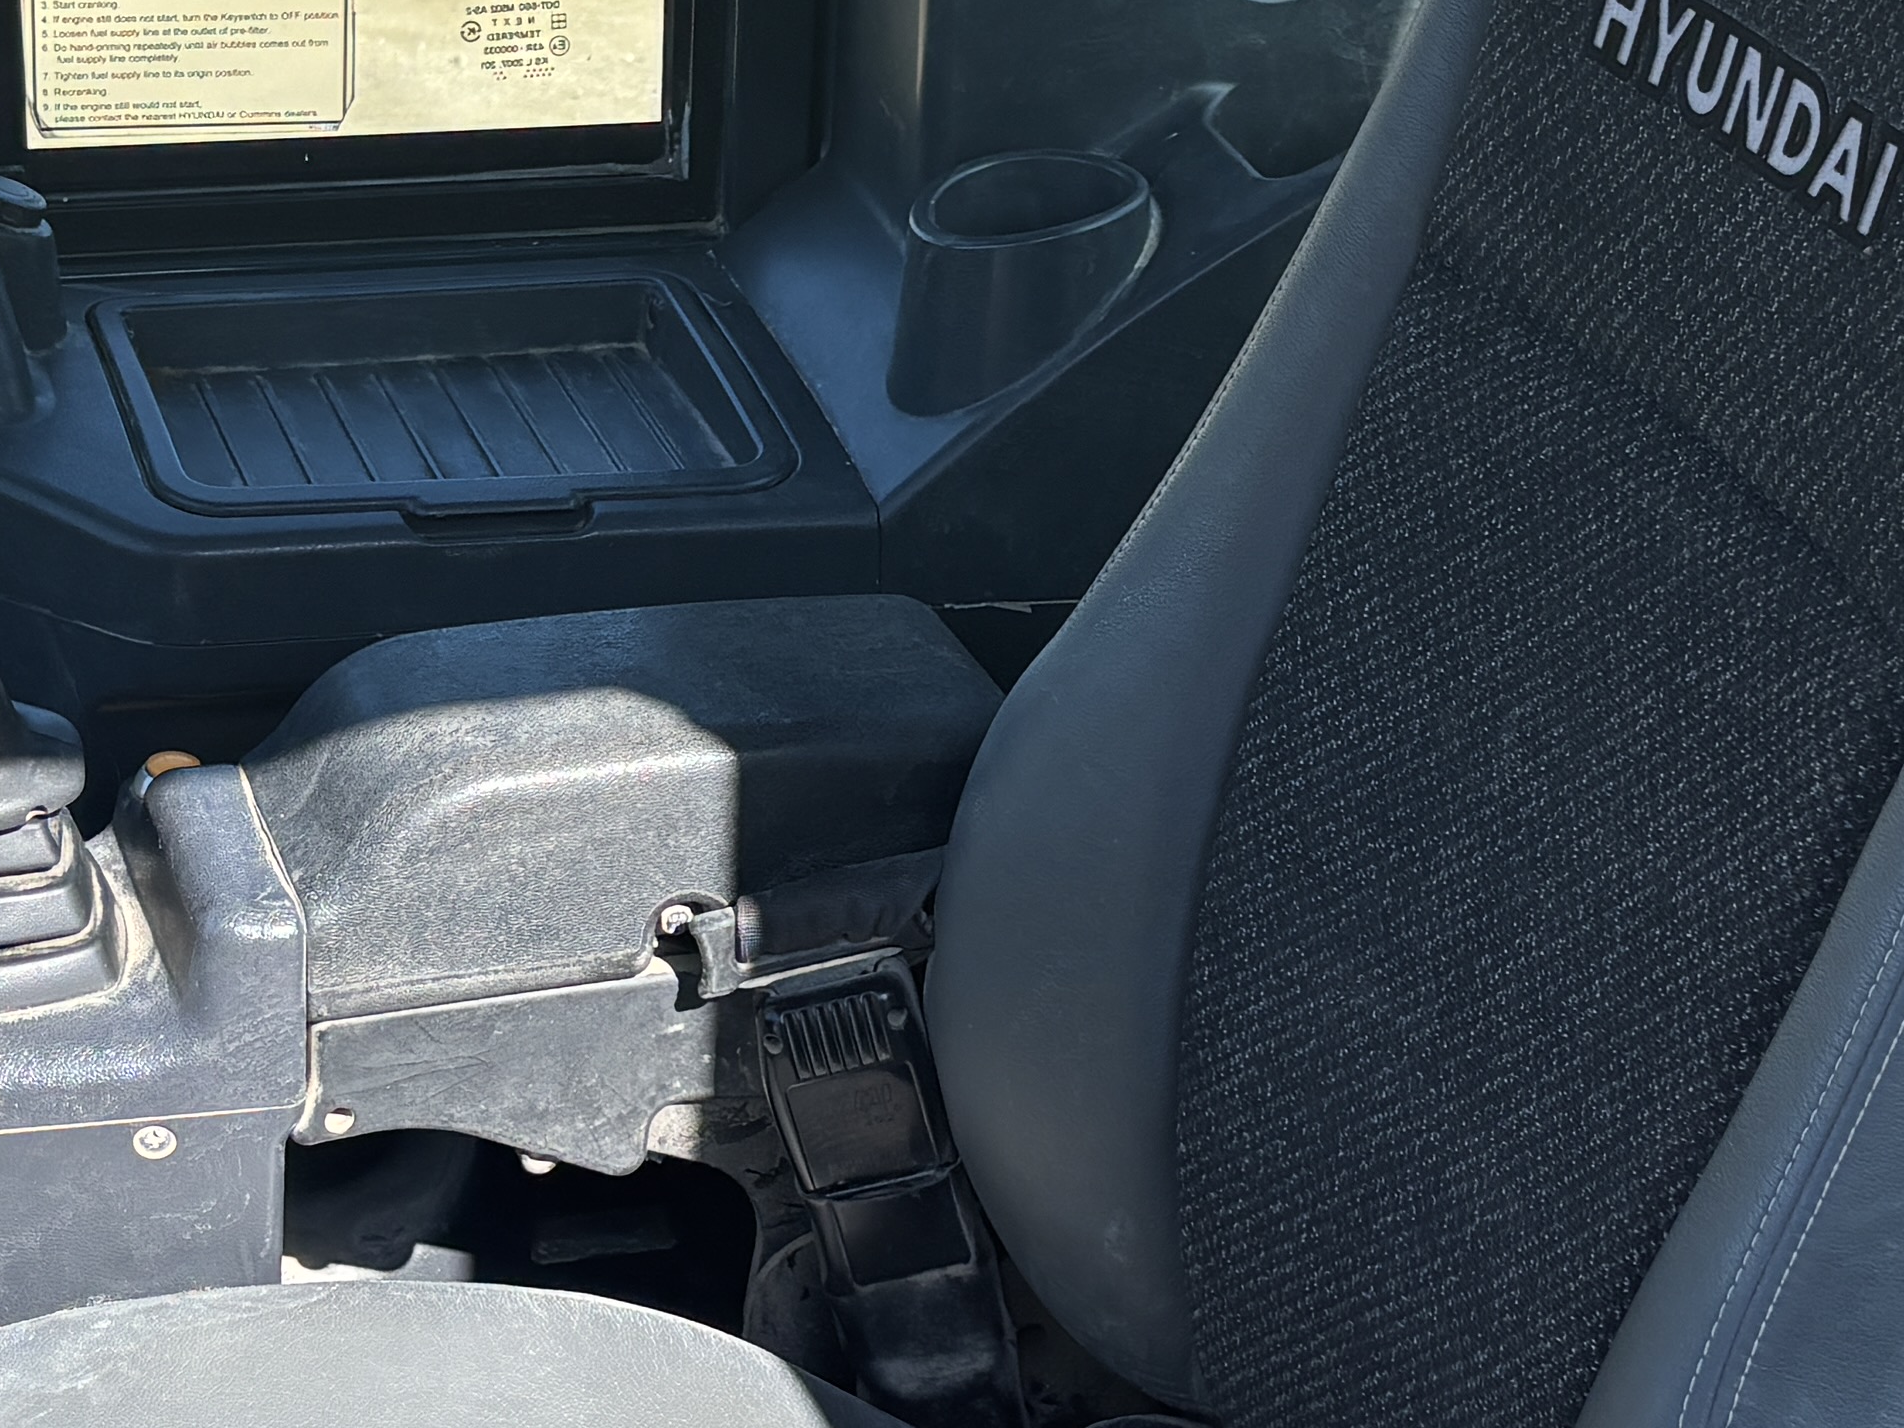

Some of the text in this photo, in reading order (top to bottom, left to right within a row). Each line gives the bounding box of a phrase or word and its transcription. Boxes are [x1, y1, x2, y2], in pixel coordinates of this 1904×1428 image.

[53, 29, 87, 37] Loosen
[110, 28, 139, 37] supply
[173, 27, 187, 35] the
[76, 55, 106, 63] supply
[54, 71, 88, 80] Tighten
[111, 70, 140, 79] supply
[174, 69, 184, 77] its
[187, 69, 212, 78] origin
